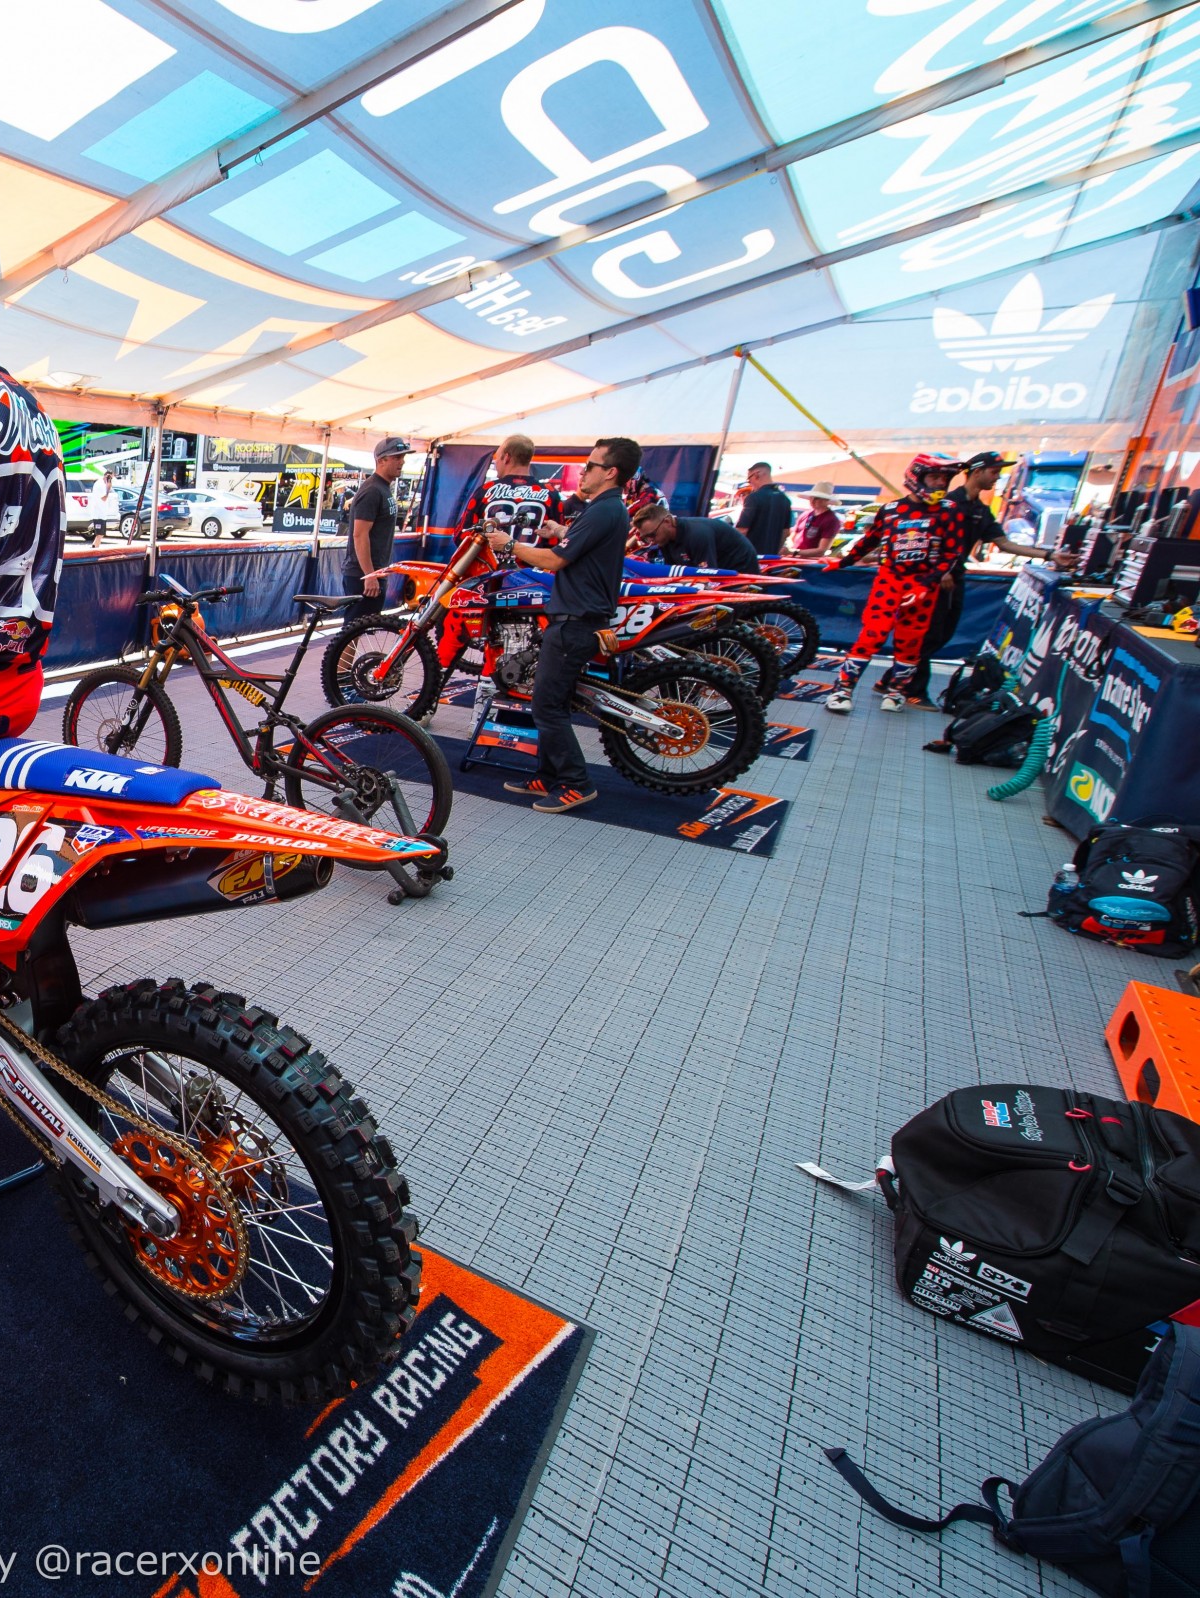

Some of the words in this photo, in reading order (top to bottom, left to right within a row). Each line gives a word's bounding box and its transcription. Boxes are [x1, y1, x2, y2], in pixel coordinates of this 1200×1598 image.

[485, 483, 550, 502] McElrath
[495, 591, 543, 600] GoPro
[64, 769, 131, 794] KTM
[11, 804, 29, 812] Twin
[136, 825, 219, 837] LIFEPROOF
[230, 833, 328, 850] DUNLOP
[1117, 882, 1155, 893] adidas
[1101, 914, 1152, 928] GoPro
[932, 1251, 970, 1273] adidas
[230, 1410, 390, 1587] FACTORY
